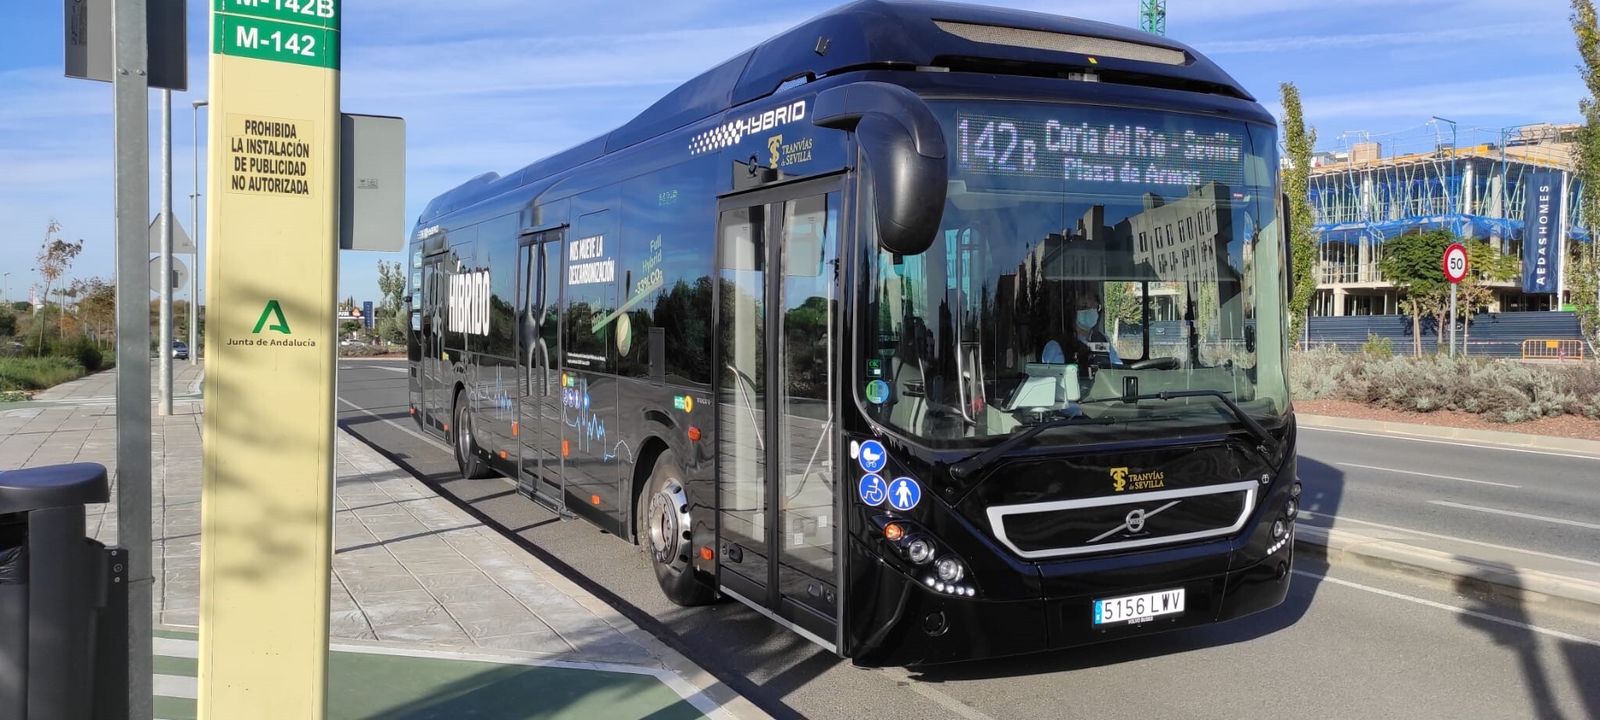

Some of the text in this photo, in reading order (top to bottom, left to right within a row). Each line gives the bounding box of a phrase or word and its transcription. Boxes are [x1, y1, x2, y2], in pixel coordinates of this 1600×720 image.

[235, 0, 335, 18] -42B
[236, 25, 316, 57] M-142
[740, 100, 806, 137] HYBRID
[244, 119, 297, 139] PROHIBIDA
[231, 137, 309, 158] LA INSTALACIÓN
[781, 137, 813, 156] TRANVÍAS
[1046, 119, 1099, 154] Coria
[1104, 124, 1130, 156] del
[1184, 130, 1239, 162] Sevilla
[234, 156, 307, 176] DE PUBLICIDAD
[786, 153, 812, 166] SEVILLA
[1064, 158, 1115, 182] Plaza
[1120, 161, 1141, 183] de
[231, 174, 309, 195] NO AUTORIZADA
[1450, 257, 1463, 270] 50
[449, 260, 490, 337] HÍBRIDO
[226, 337, 316, 348] Junta de Andalucía
[1128, 470, 1164, 482] TRANVÍAS
[1134, 480, 1164, 490] SEVILLA
[1104, 591, 1180, 620] 5156 LWV
